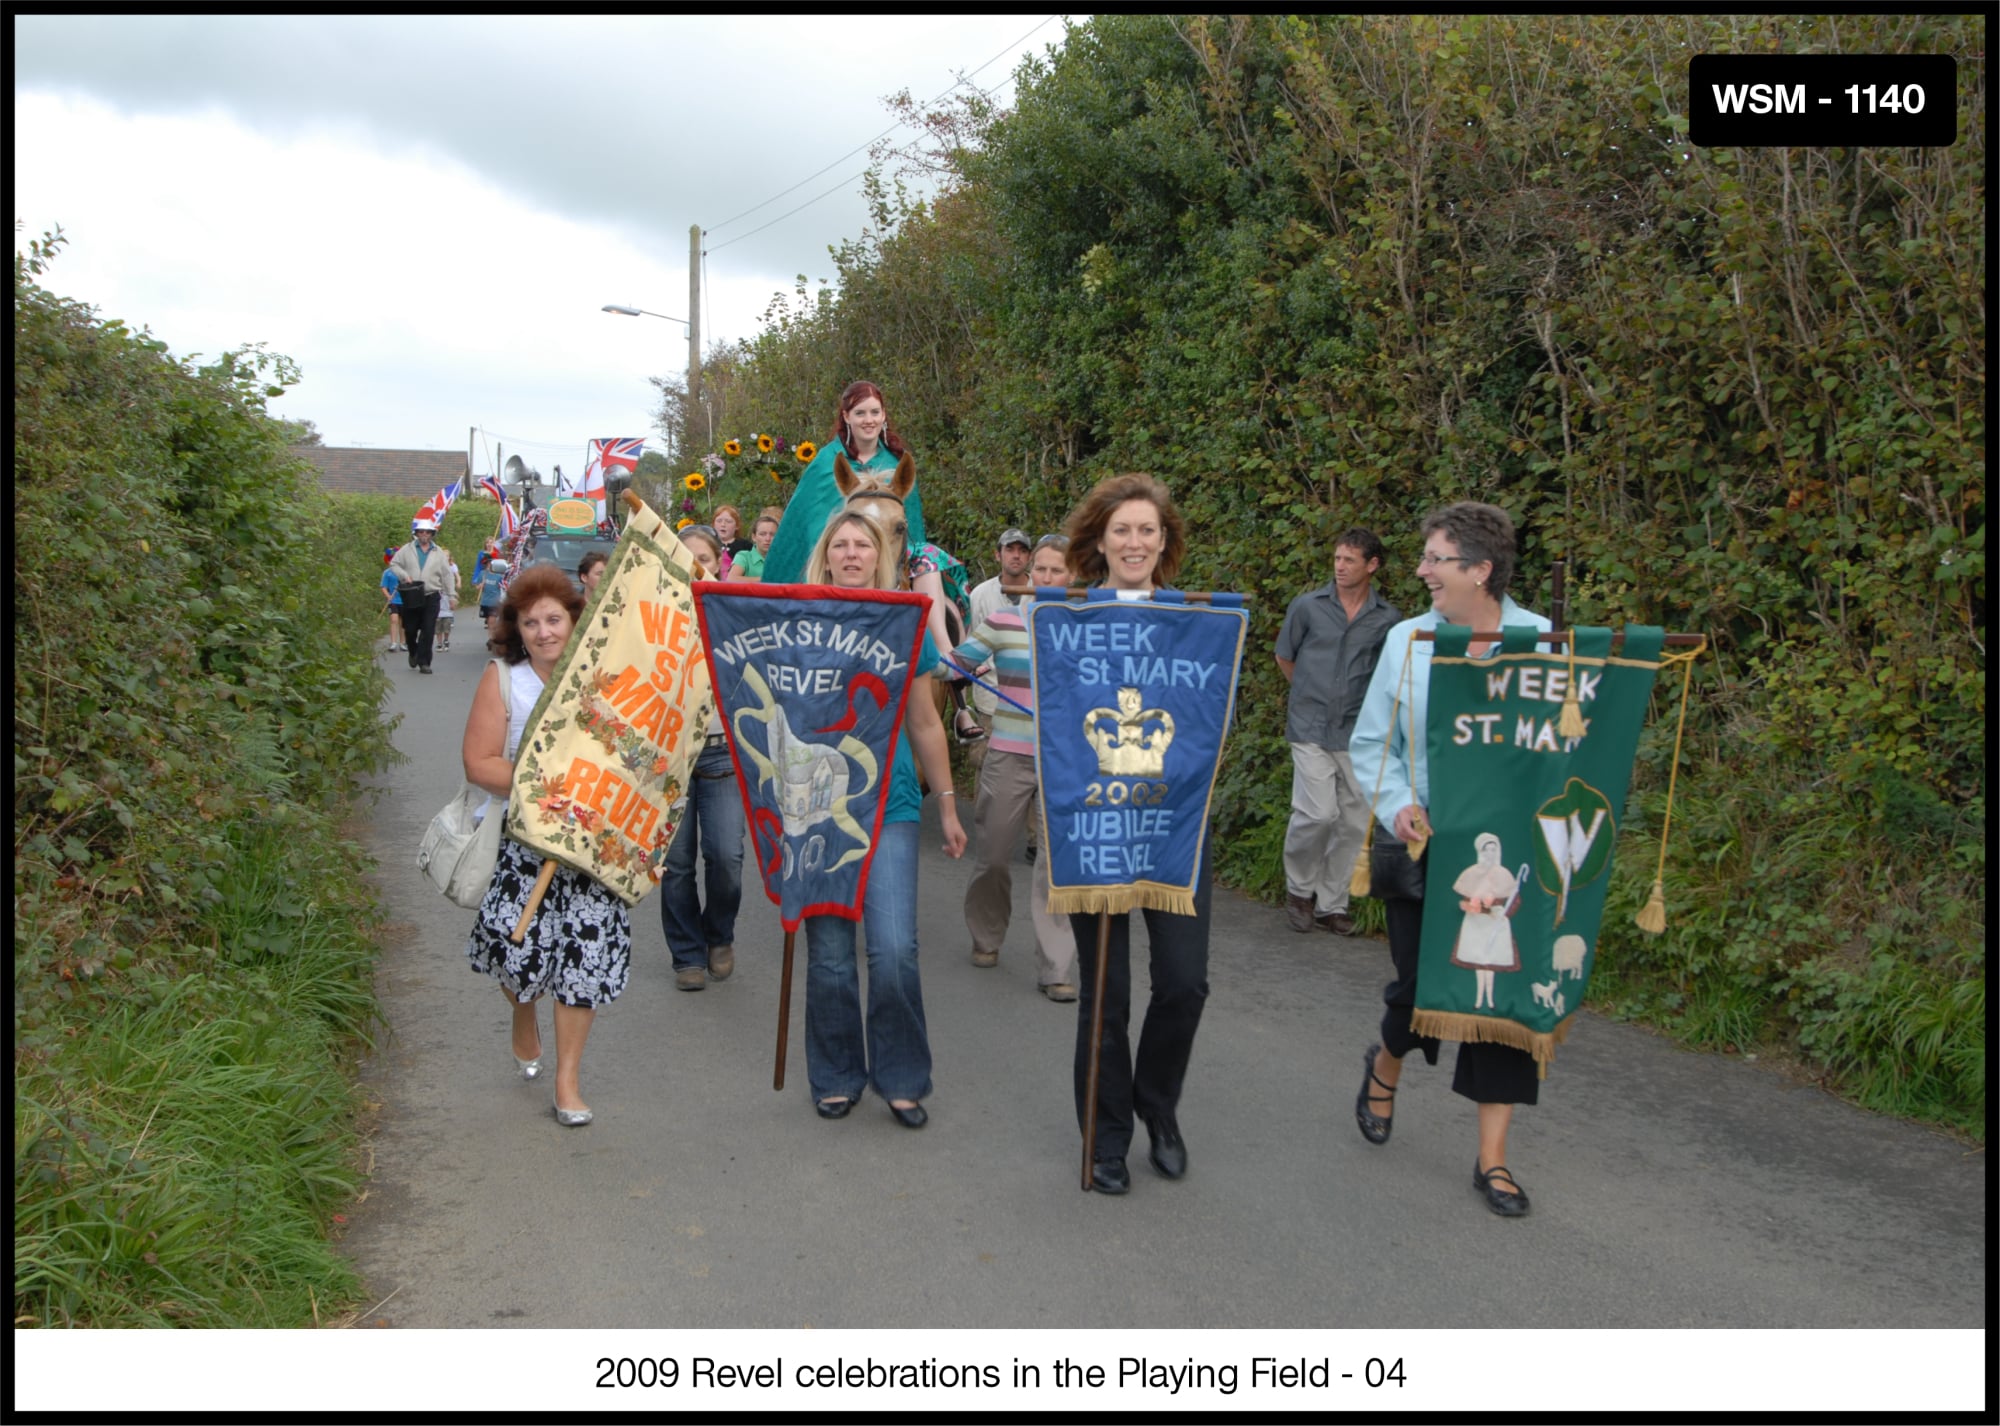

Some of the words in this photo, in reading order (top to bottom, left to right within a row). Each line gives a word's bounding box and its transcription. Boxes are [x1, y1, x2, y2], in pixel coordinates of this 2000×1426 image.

[714, 621, 793, 665] WEEK
[795, 620, 822, 647] St
[826, 623, 908, 676] MARY
[1049, 623, 1157, 653] WEEK
[767, 663, 843, 695] REVEL
[1078, 657, 1110, 686] St
[1124, 655, 1217, 689] MARY
[1486, 666, 1603, 702] WEEK
[601, 664, 686, 758] MAR
[565, 757, 661, 852] REVEL
[1085, 781, 1169, 806] 2002
[1067, 809, 1173, 842] JUBILEE
[1080, 844, 1155, 875] REVEL
